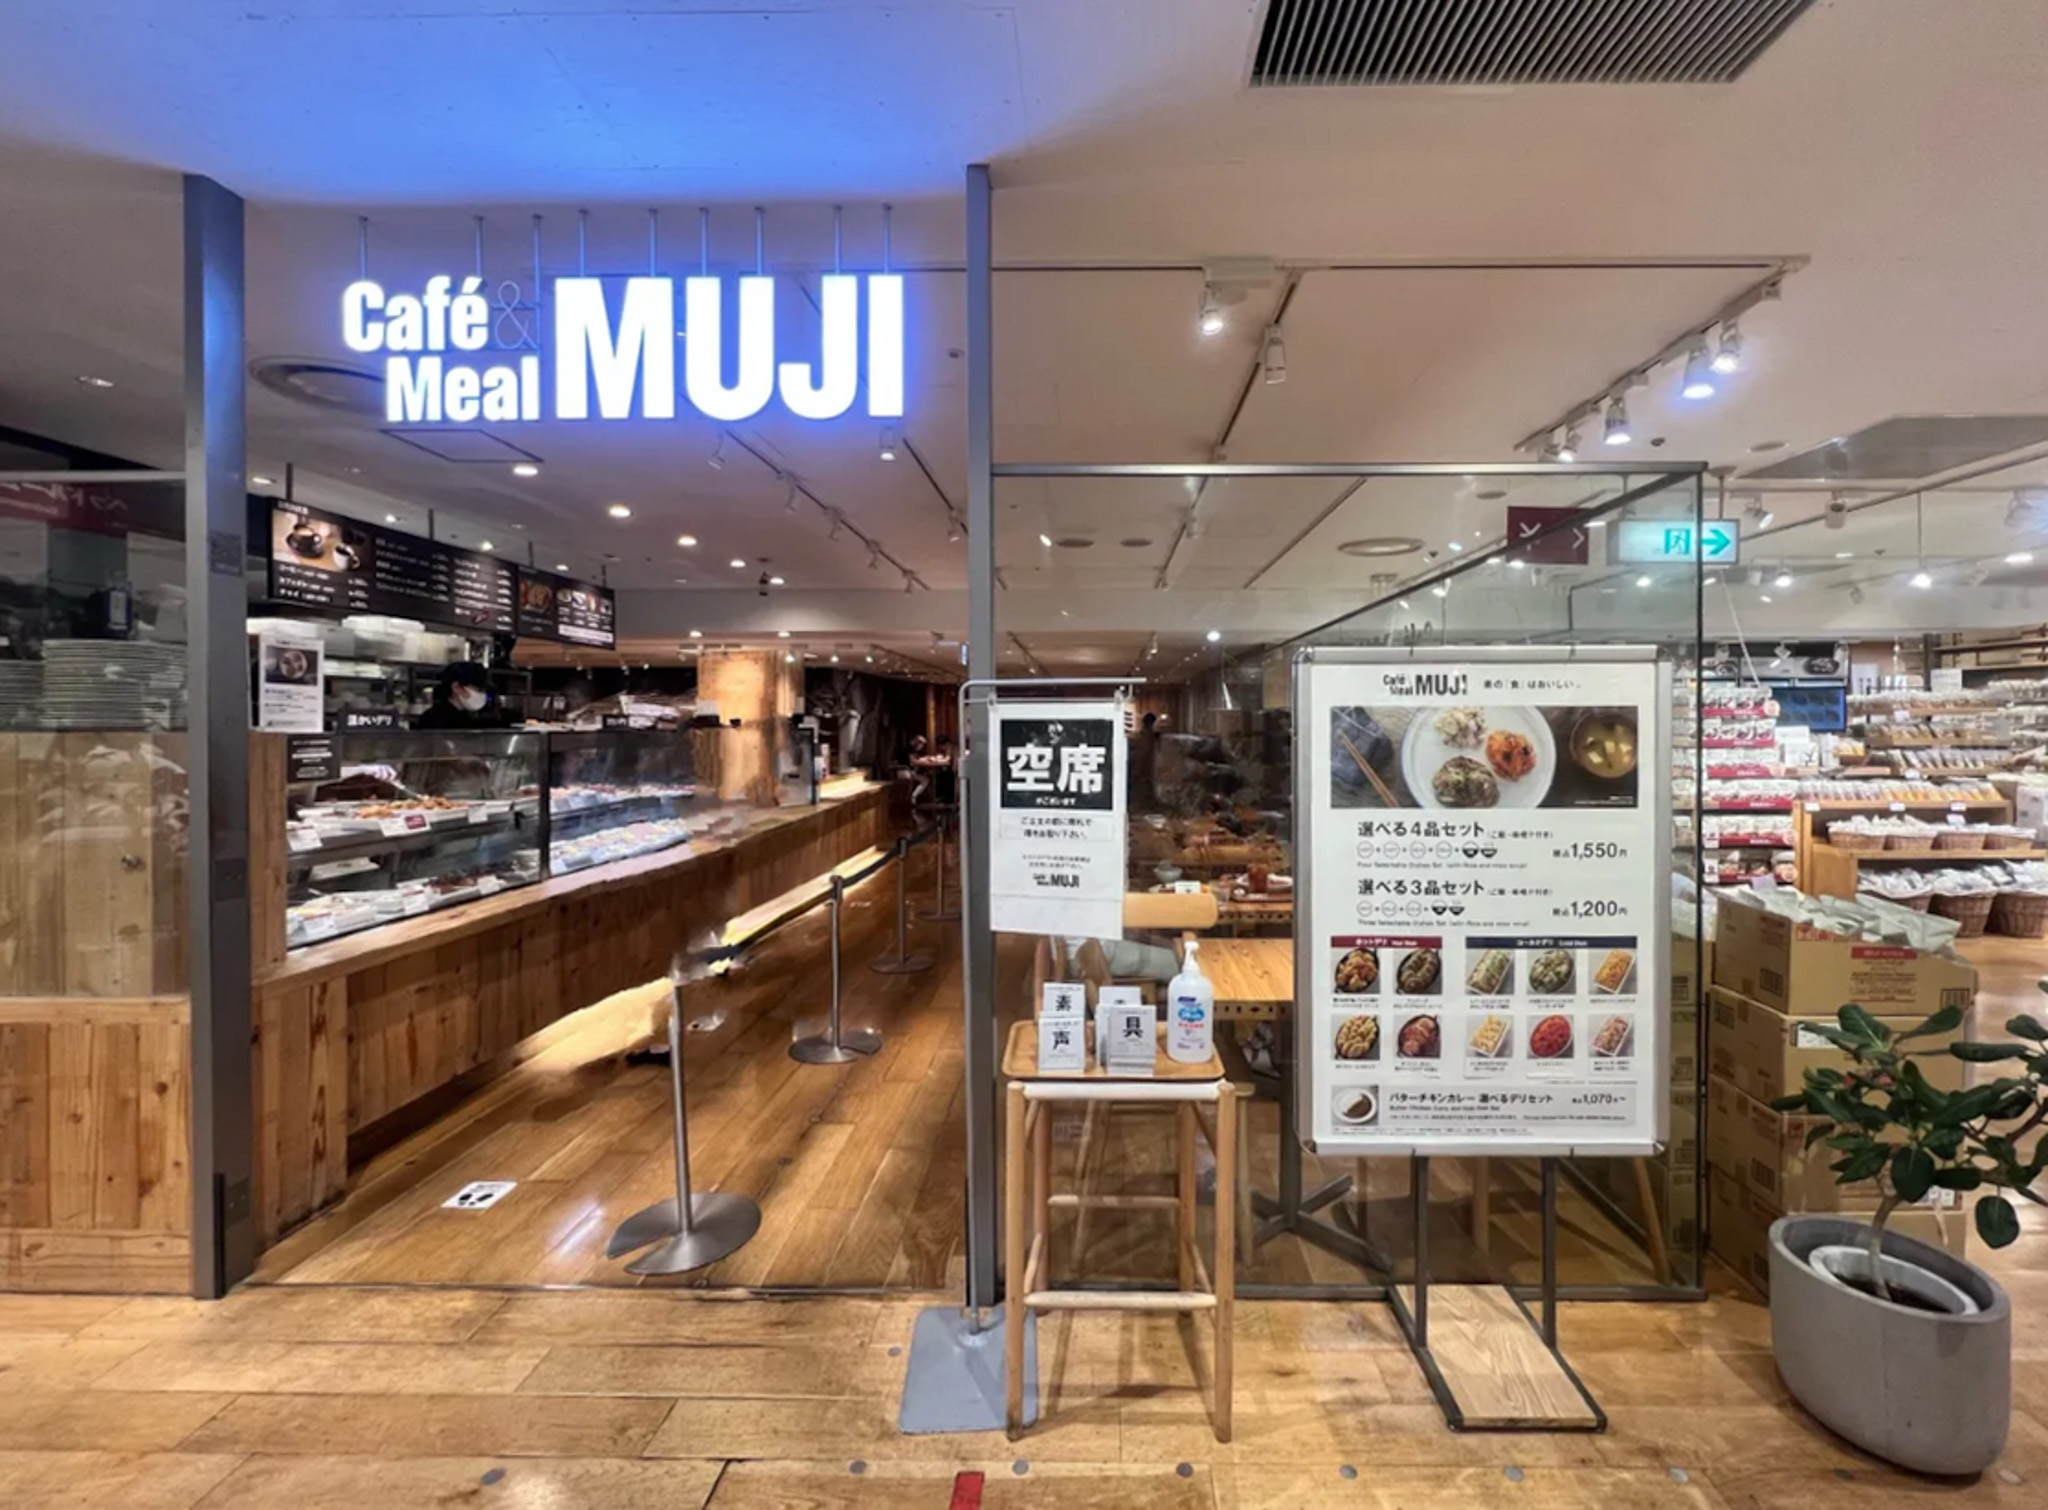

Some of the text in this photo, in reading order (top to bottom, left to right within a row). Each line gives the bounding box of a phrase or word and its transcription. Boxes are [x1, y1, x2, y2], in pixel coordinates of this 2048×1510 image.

[342, 278, 538, 351] Café &
[555, 275, 904, 421] MUJI
[386, 356, 540, 422] Meal
[1415, 674, 1468, 696] MUJI
[1007, 742, 1107, 794] 空席
[1358, 821, 1485, 838] 選べる4品セット
[1051, 874, 1080, 889] MUJI
[1358, 879, 1485, 896] 選べる3品セット
[1055, 994, 1071, 1012] 素
[1123, 1016, 1144, 1039] 具
[1052, 1031, 1071, 1050] 声
[1389, 1093, 1475, 1104] バターチキンカレー
